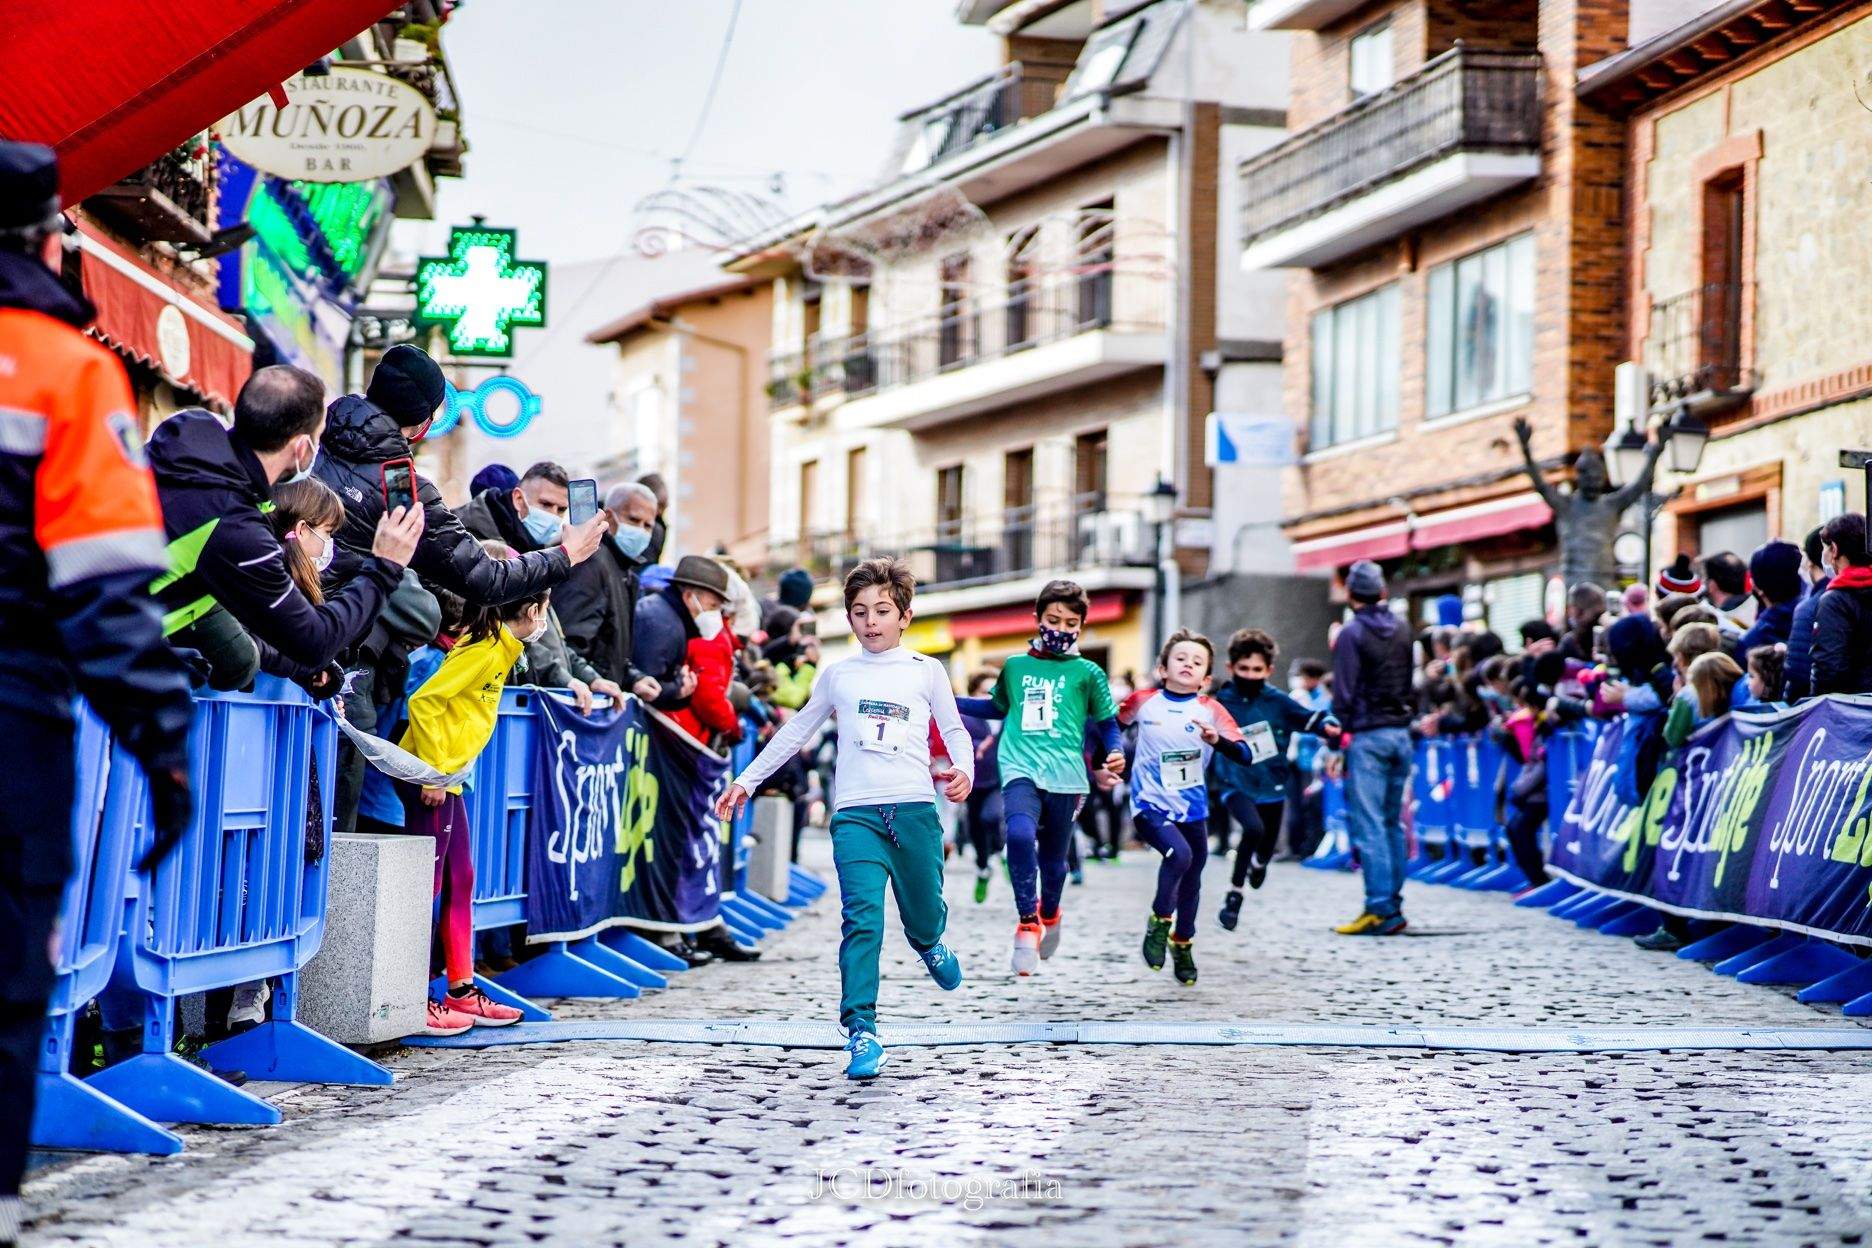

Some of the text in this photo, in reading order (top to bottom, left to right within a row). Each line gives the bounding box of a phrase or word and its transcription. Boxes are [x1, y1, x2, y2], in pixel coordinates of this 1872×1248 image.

[288, 75, 400, 98] STAURANTE
[305, 157, 353, 171] BAR
[1037, 706, 1044, 721] 1
[876, 722, 886, 741] 1
[1180, 767, 1186, 781] 1
